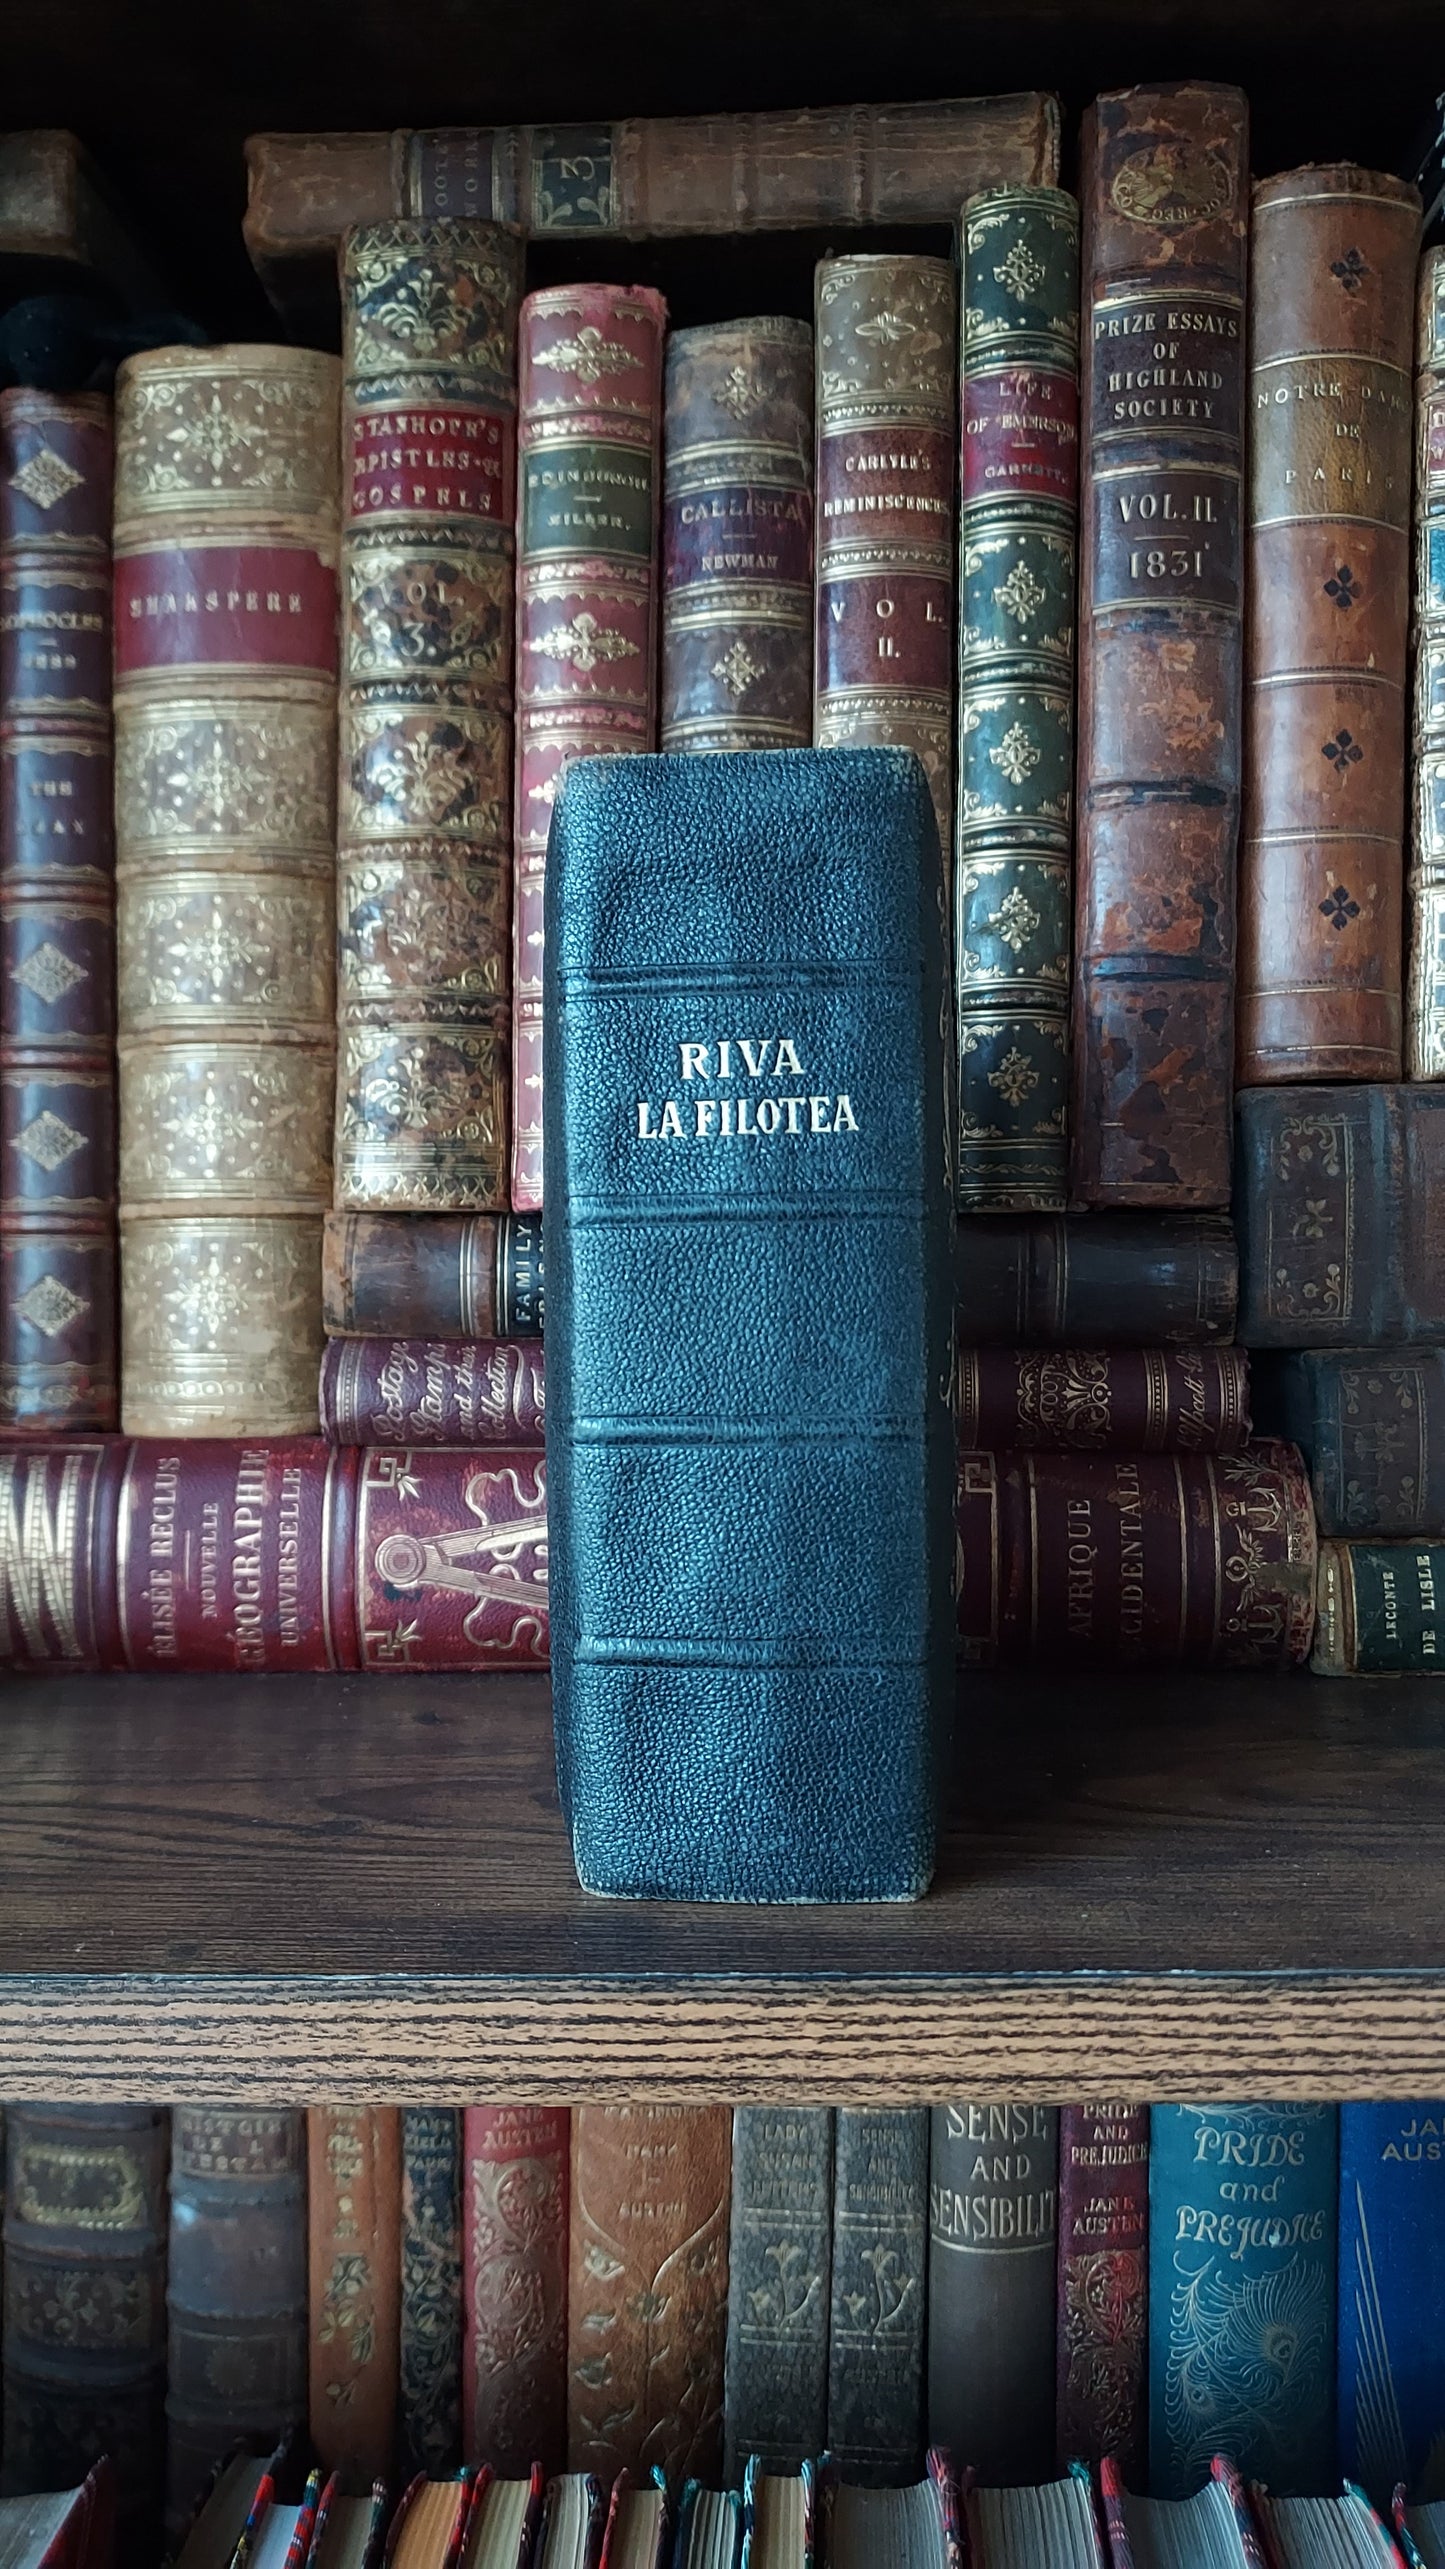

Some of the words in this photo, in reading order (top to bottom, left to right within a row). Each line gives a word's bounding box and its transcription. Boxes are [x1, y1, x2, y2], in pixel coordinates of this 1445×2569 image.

[1094, 312, 1157, 340] PRIZE
[1166, 311, 1238, 338] ESSAYS
[1153, 341, 1180, 360] OF
[999, 381, 1052, 401] LIFE
[1108, 368, 1224, 393] HIGHLAND
[1113, 398, 1217, 421] SOCIETY
[966, 417, 989, 435] OF
[1335, 422, 1361, 439] DE
[845, 448, 932, 473] CARLYLE'S
[1284, 466, 1394, 490] PARIS
[352, 484, 493, 513] GOSPELS
[681, 498, 801, 525] CALLISTA
[1119, 493, 1189, 524] VOL.
[701, 552, 779, 572] NEWMAN
[1129, 550, 1203, 580] 1831
[878, 635, 901, 659] II.
[678, 1038, 806, 1081] RIVA
[636, 1099, 689, 1140] LA
[694, 1093, 860, 1138] FILOTEA
[515, 1223, 533, 1321] FAMILY
[370, 1341, 419, 1443] Postage
[149, 1456, 181, 1558] RECLUS
[200, 1501, 220, 1620] NOUVELLE
[278, 1467, 301, 1648] UNIVERSELLE
[1067, 1499, 1098, 1638] AFRIQUE
[1114, 1462, 1145, 1660] CIDENTALE
[1415, 1554, 1436, 1612] LISLE
[1382, 1571, 1398, 1640] LECONTE
[1421, 1629, 1436, 1655] DE
[493, 2105, 545, 2128] JANE
[945, 2104, 1048, 2146] SENSE
[1082, 2103, 1140, 2120] PRIDE
[481, 2121, 559, 2151] AUSTEN
[764, 2124, 808, 2140] LADY
[1093, 2124, 1129, 2141] AND
[1400, 2117, 1445, 2138] JA
[1070, 2141, 1149, 2167] PREJUDICE
[1193, 2126, 1305, 2168] PRIDE
[969, 2153, 1032, 2183] AND
[1218, 2175, 1286, 2203] and
[930, 2181, 1055, 2242] SENSIBILIT
[1083, 2196, 1135, 2214] JANE
[1072, 2211, 1145, 2237] AUSTEN
[1173, 2204, 1327, 2263] PREJUDICE
